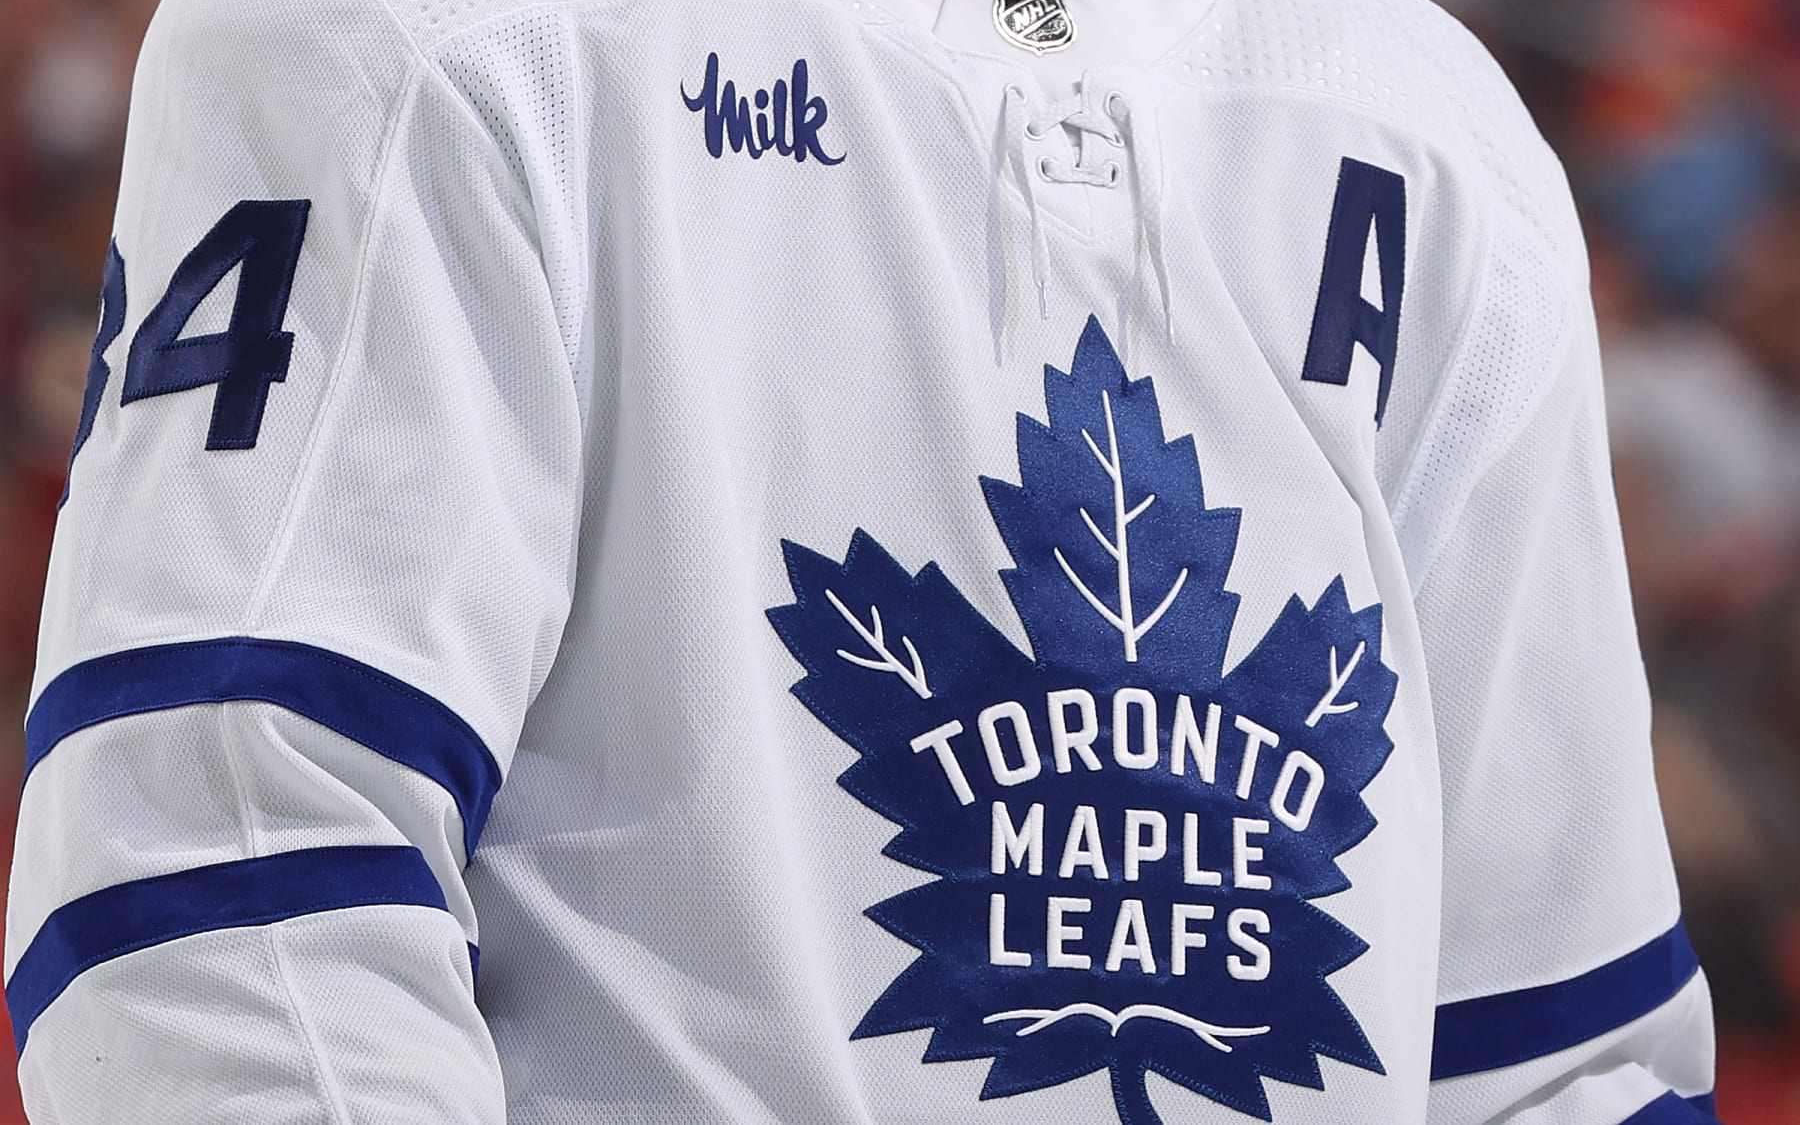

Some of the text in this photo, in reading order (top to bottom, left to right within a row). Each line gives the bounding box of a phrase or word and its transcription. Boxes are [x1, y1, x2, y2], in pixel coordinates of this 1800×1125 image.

[680, 52, 848, 166] Milk
[1301, 156, 1407, 432] A
[910, 687, 1326, 833] TORONTO
[990, 801, 1272, 891] MAPLE
[988, 893, 1272, 982] LEAFS
